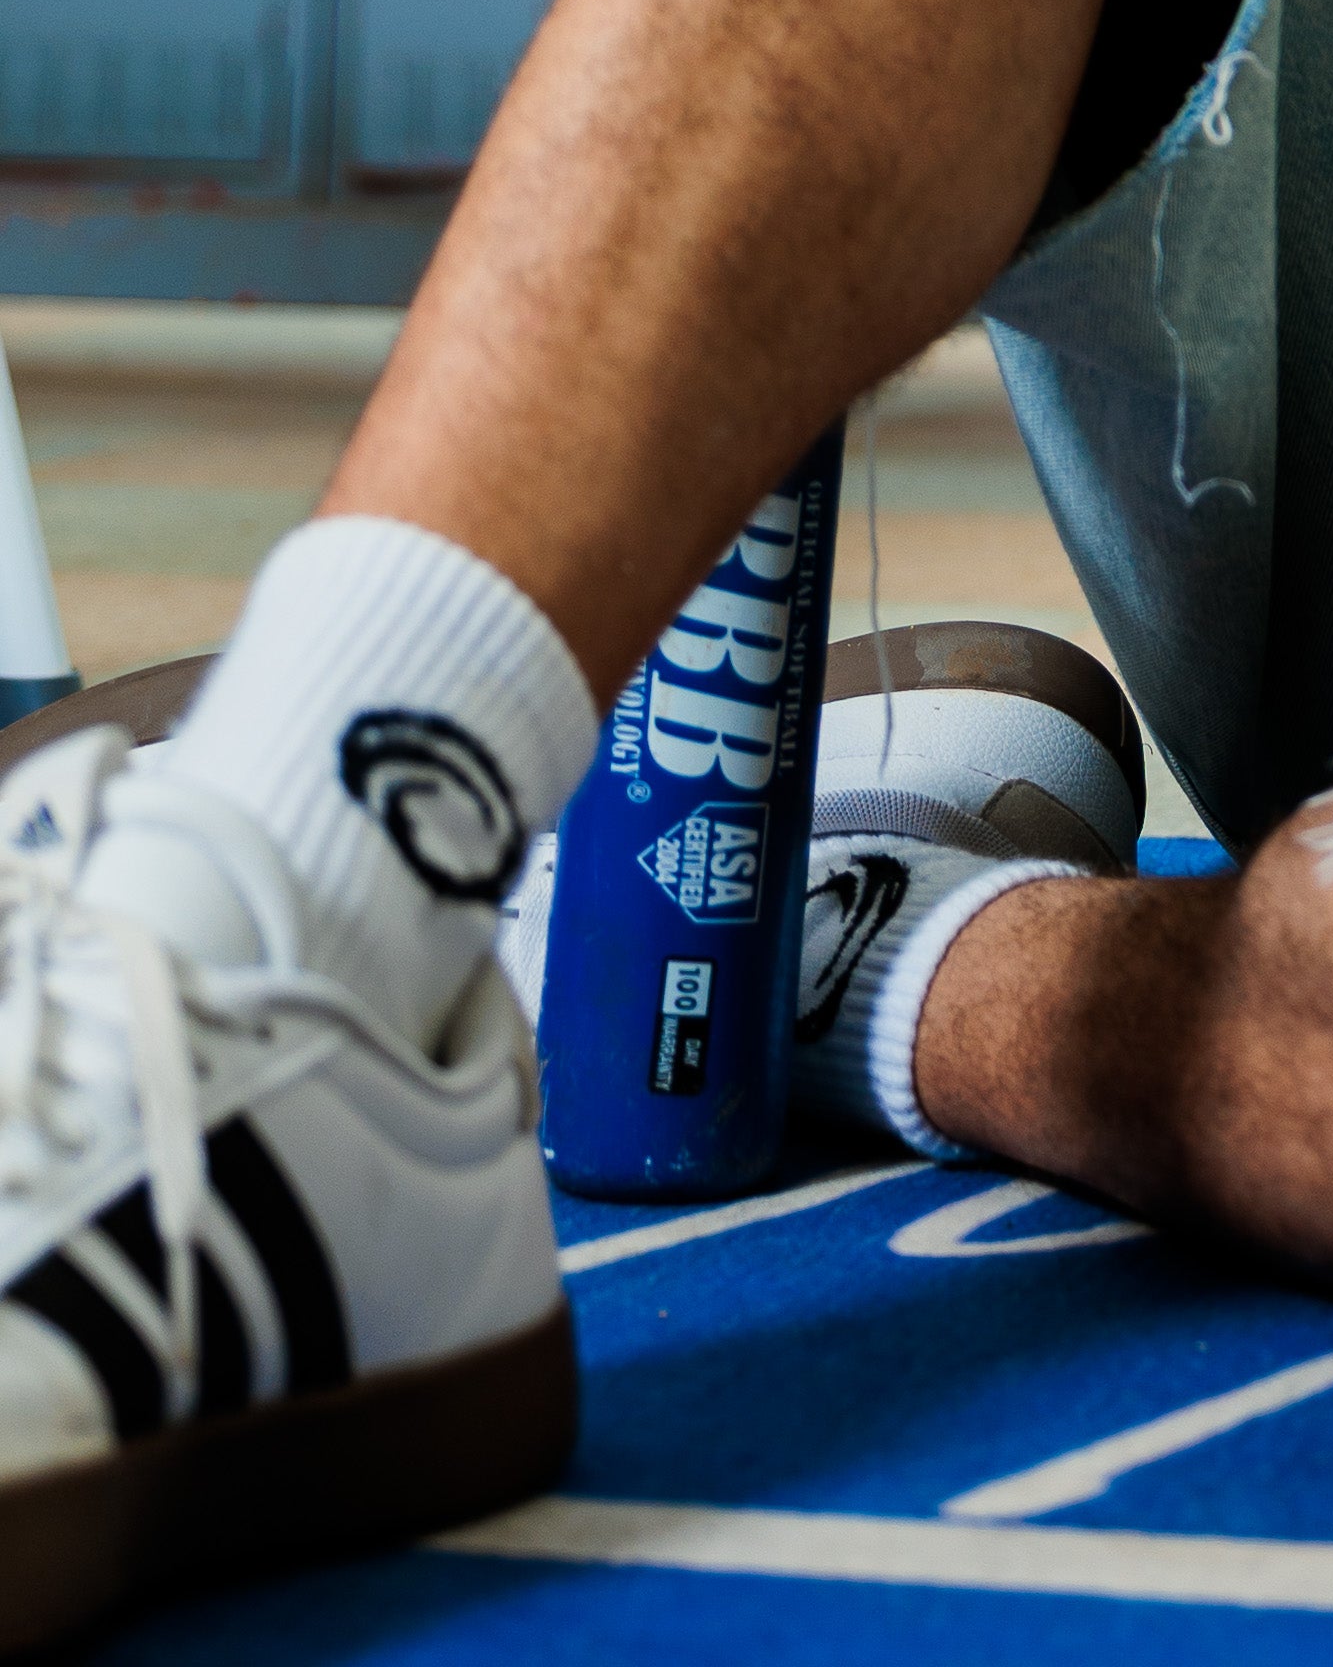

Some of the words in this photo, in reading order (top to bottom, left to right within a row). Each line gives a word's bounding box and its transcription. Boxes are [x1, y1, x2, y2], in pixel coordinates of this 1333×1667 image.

[797, 480, 823, 609] OFFICIAL
[779, 623, 807, 774] SOFTBALL
[655, 836, 681, 885] 2004
[679, 816, 709, 909] CERTIFIED
[707, 821, 760, 907] ASA
[674, 966, 701, 1012] 100
